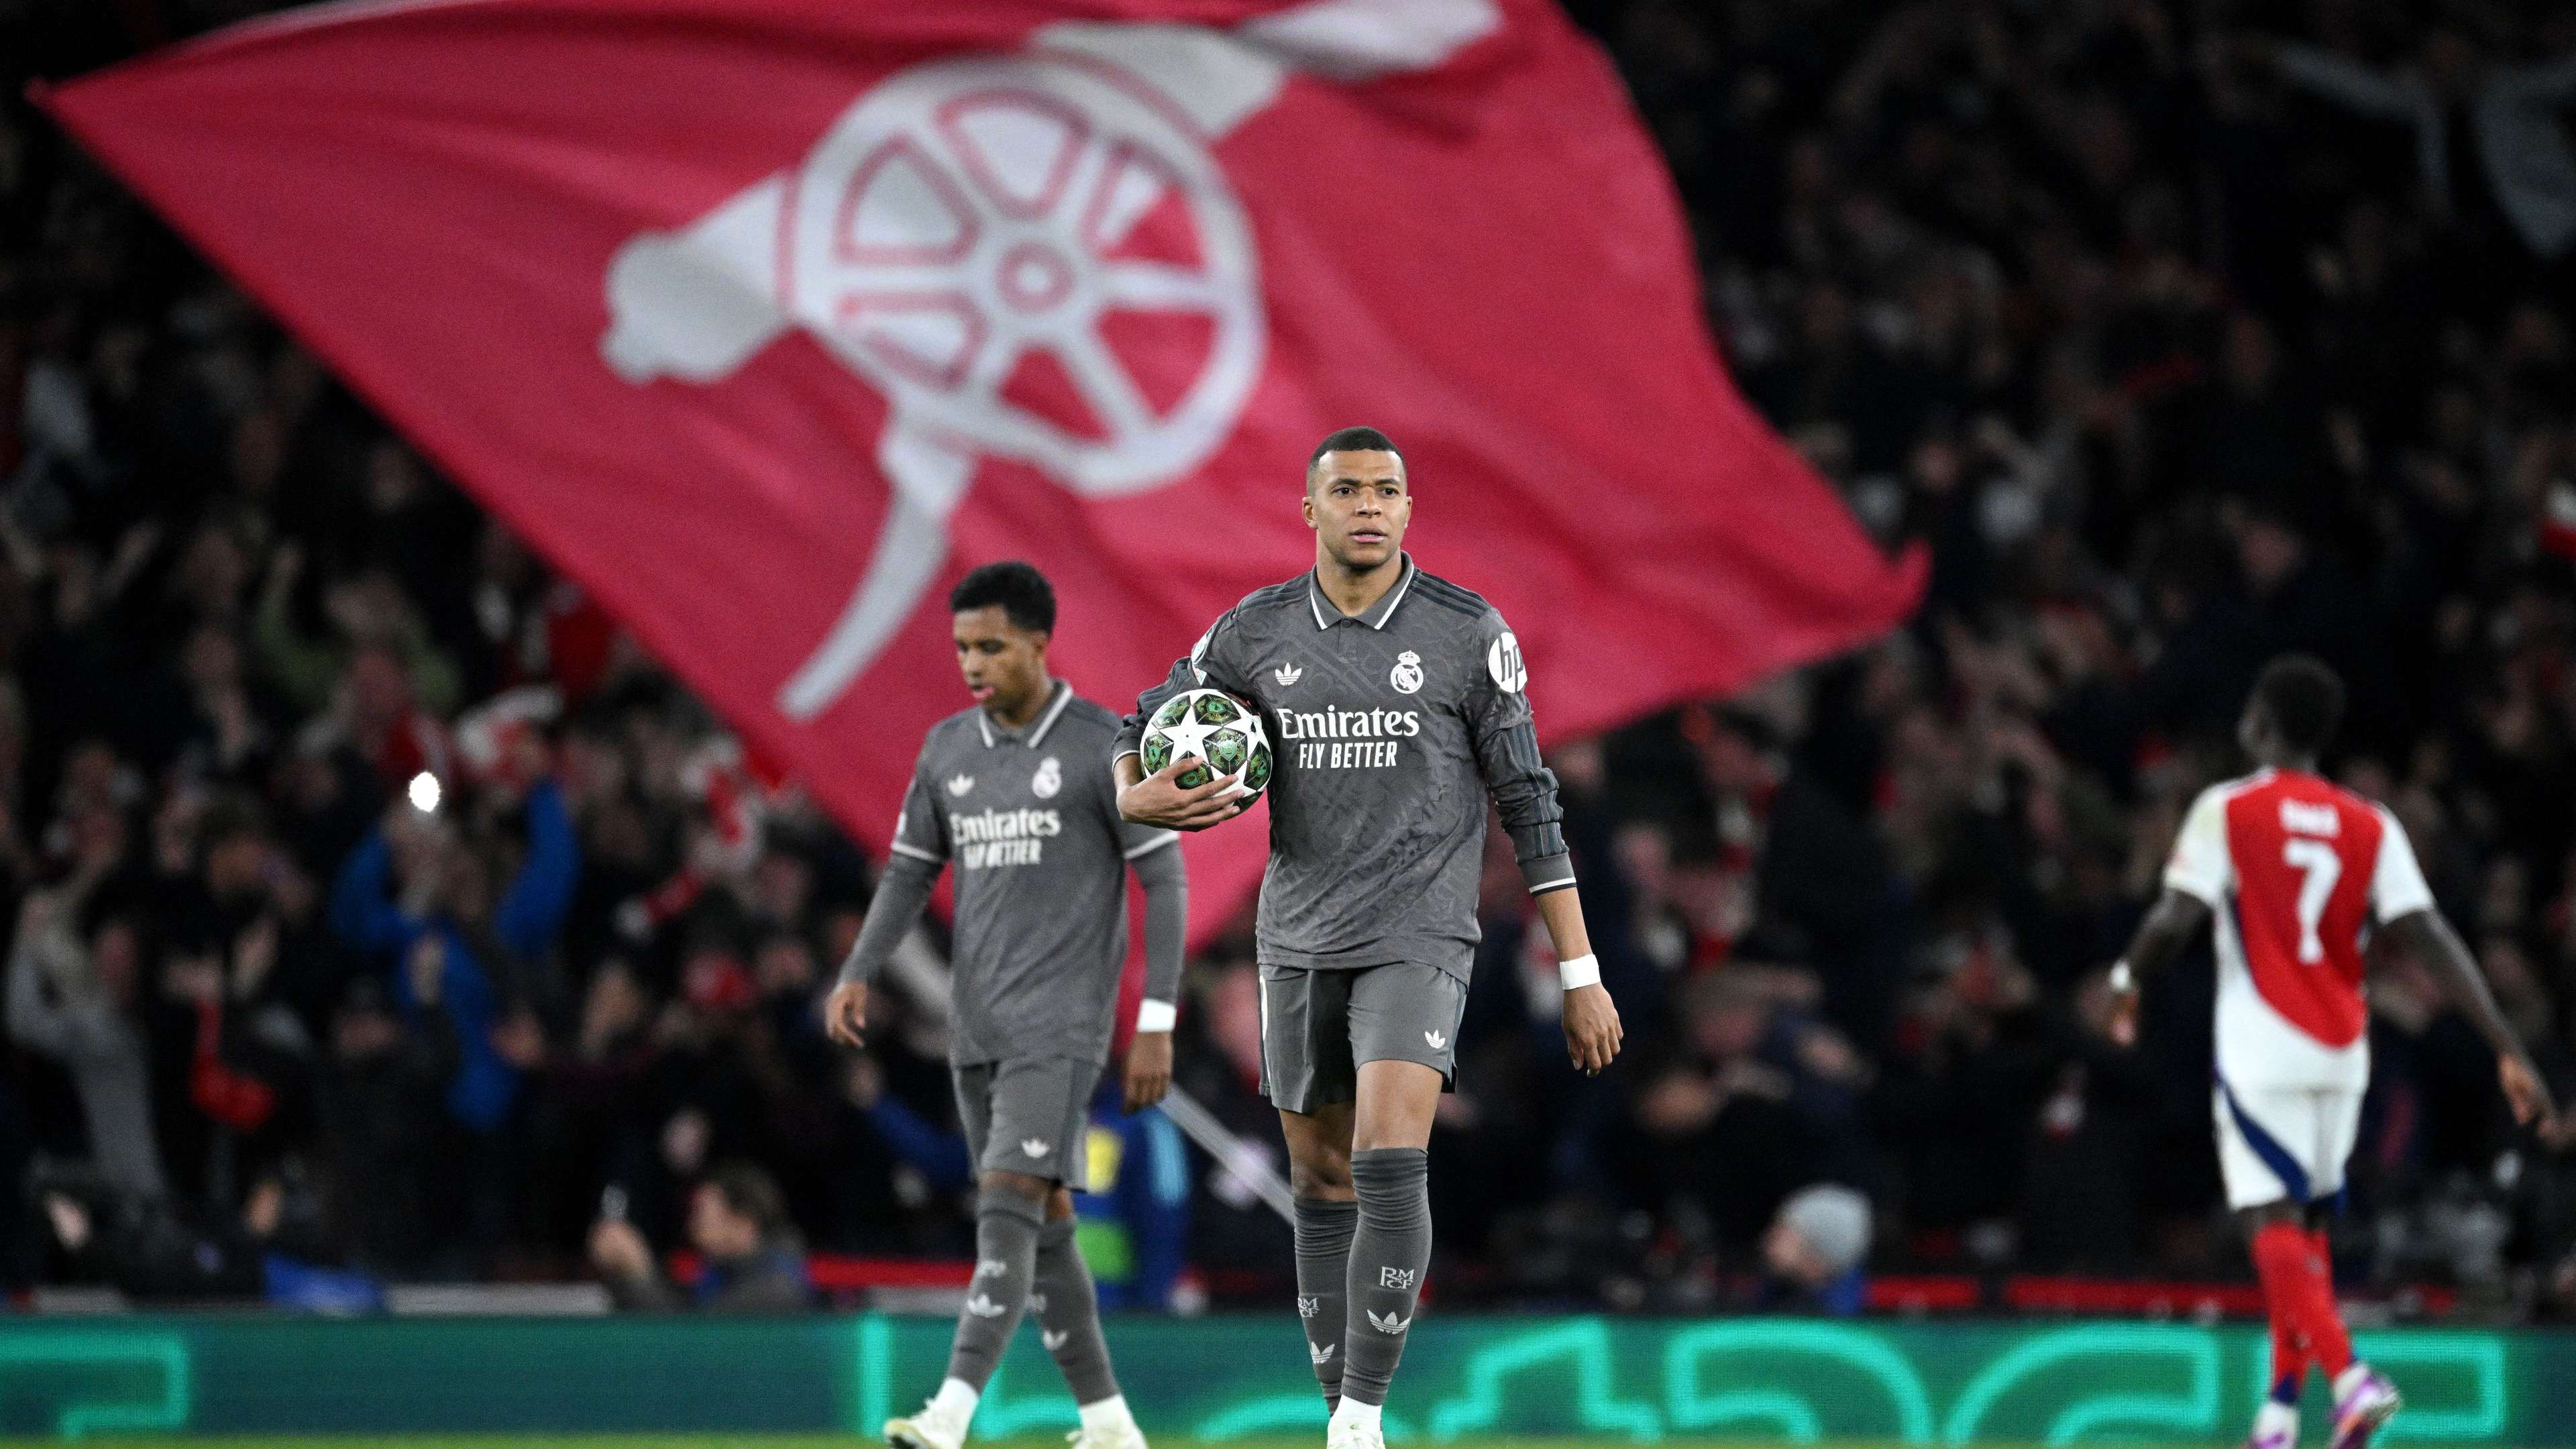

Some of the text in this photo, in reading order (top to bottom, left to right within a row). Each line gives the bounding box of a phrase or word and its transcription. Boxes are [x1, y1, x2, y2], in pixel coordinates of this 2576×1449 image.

[1498, 635, 1524, 692] hp
[1277, 704, 1420, 739] Emirates
[1299, 741, 1398, 769] FLY BETTER
[950, 808, 1061, 846] Emirates
[2284, 839, 2343, 965] 7
